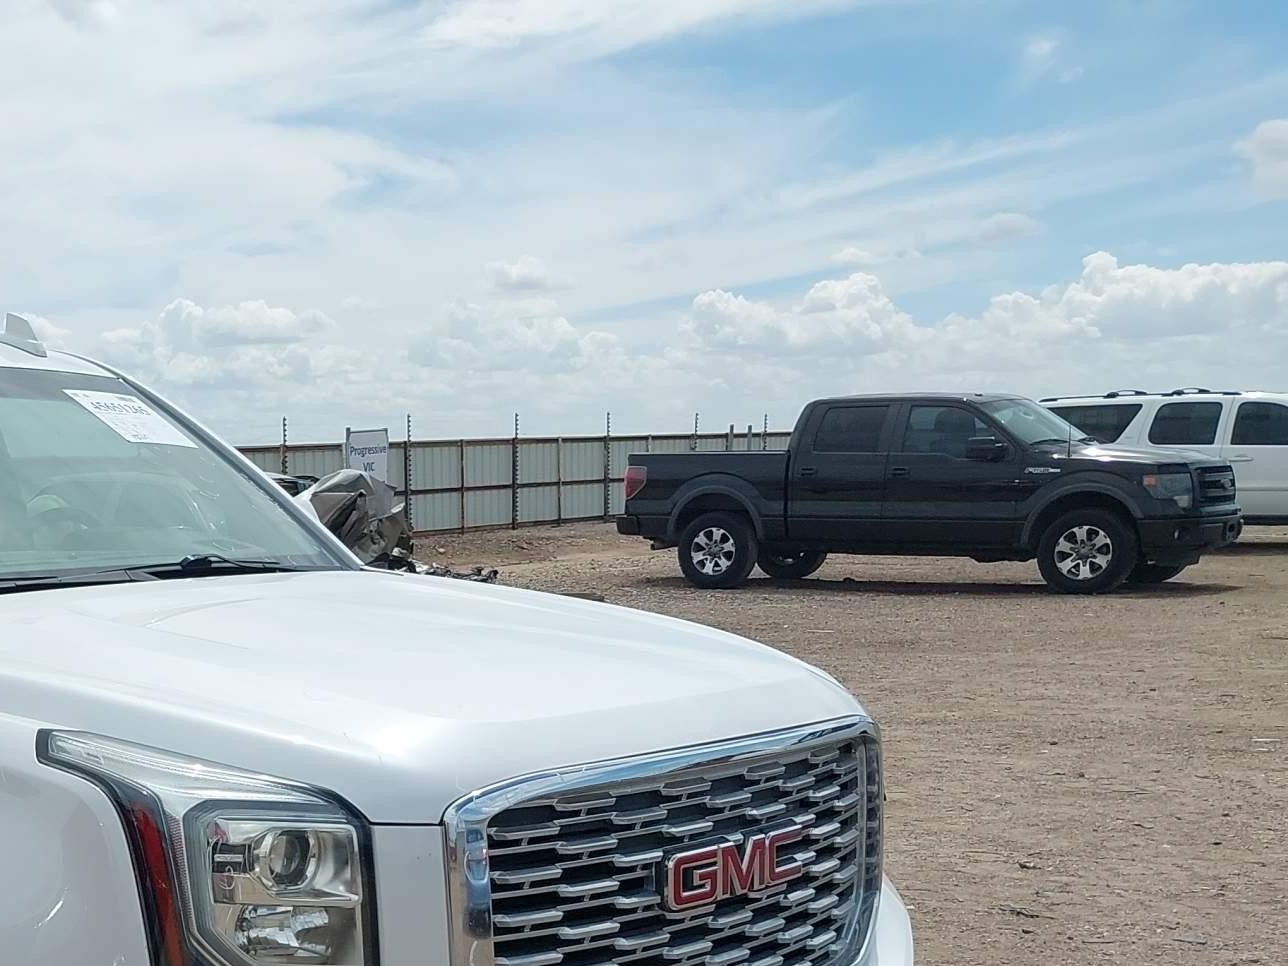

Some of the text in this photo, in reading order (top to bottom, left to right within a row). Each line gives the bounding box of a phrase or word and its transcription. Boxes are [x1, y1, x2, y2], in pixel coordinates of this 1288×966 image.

[349, 445, 387, 458] Progressive
[362, 461, 376, 472] VIC
[667, 824, 803, 911] GMC
